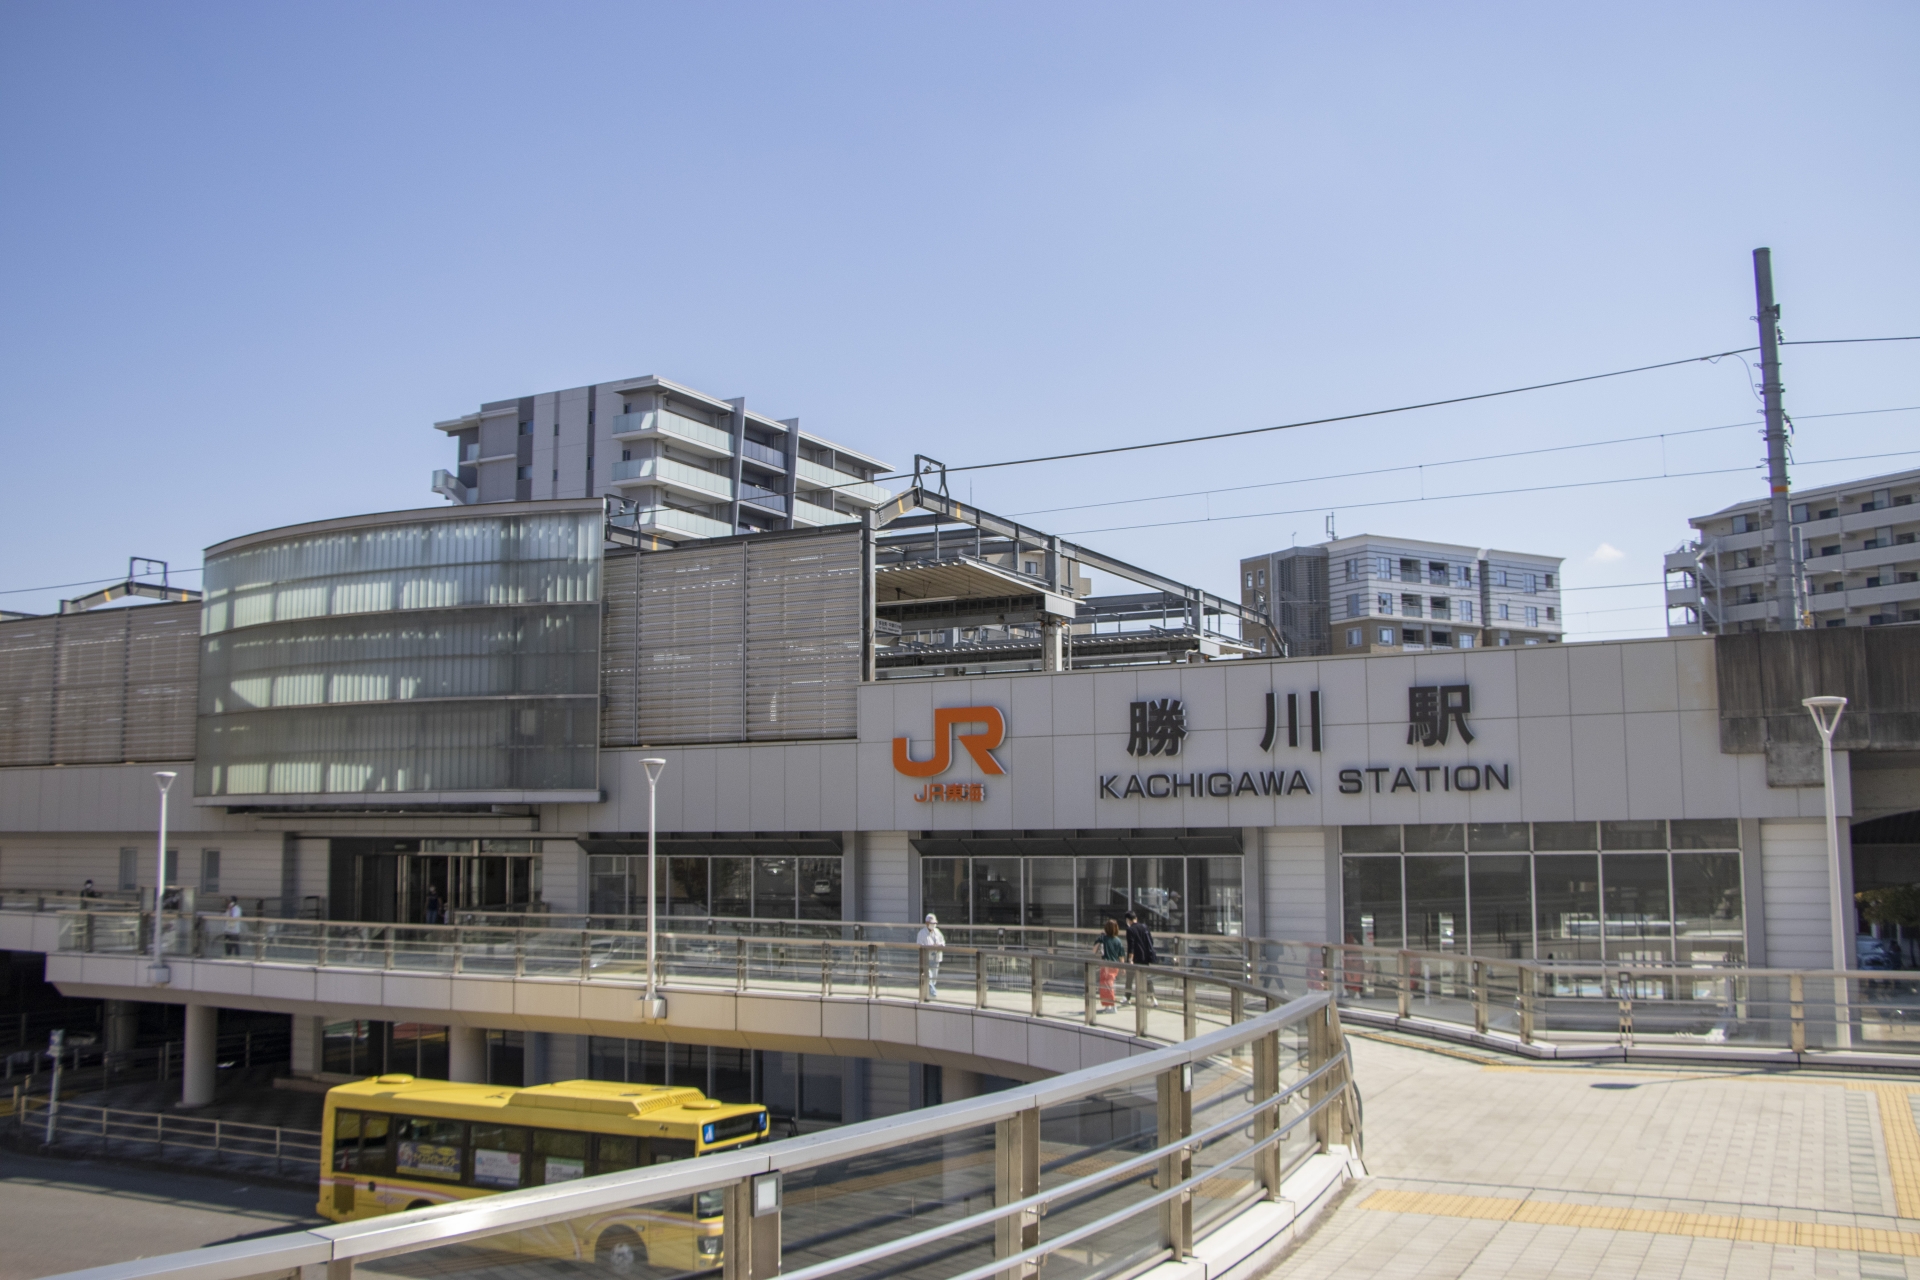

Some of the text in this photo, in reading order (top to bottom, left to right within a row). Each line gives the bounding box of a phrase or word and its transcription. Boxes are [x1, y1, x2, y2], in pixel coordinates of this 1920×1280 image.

[892, 706, 1006, 777] JR
[1126, 685, 1476, 758] 勝川駅
[914, 783, 985, 803] JR東海
[1099, 763, 1510, 800] KACHIGAWA STATION
